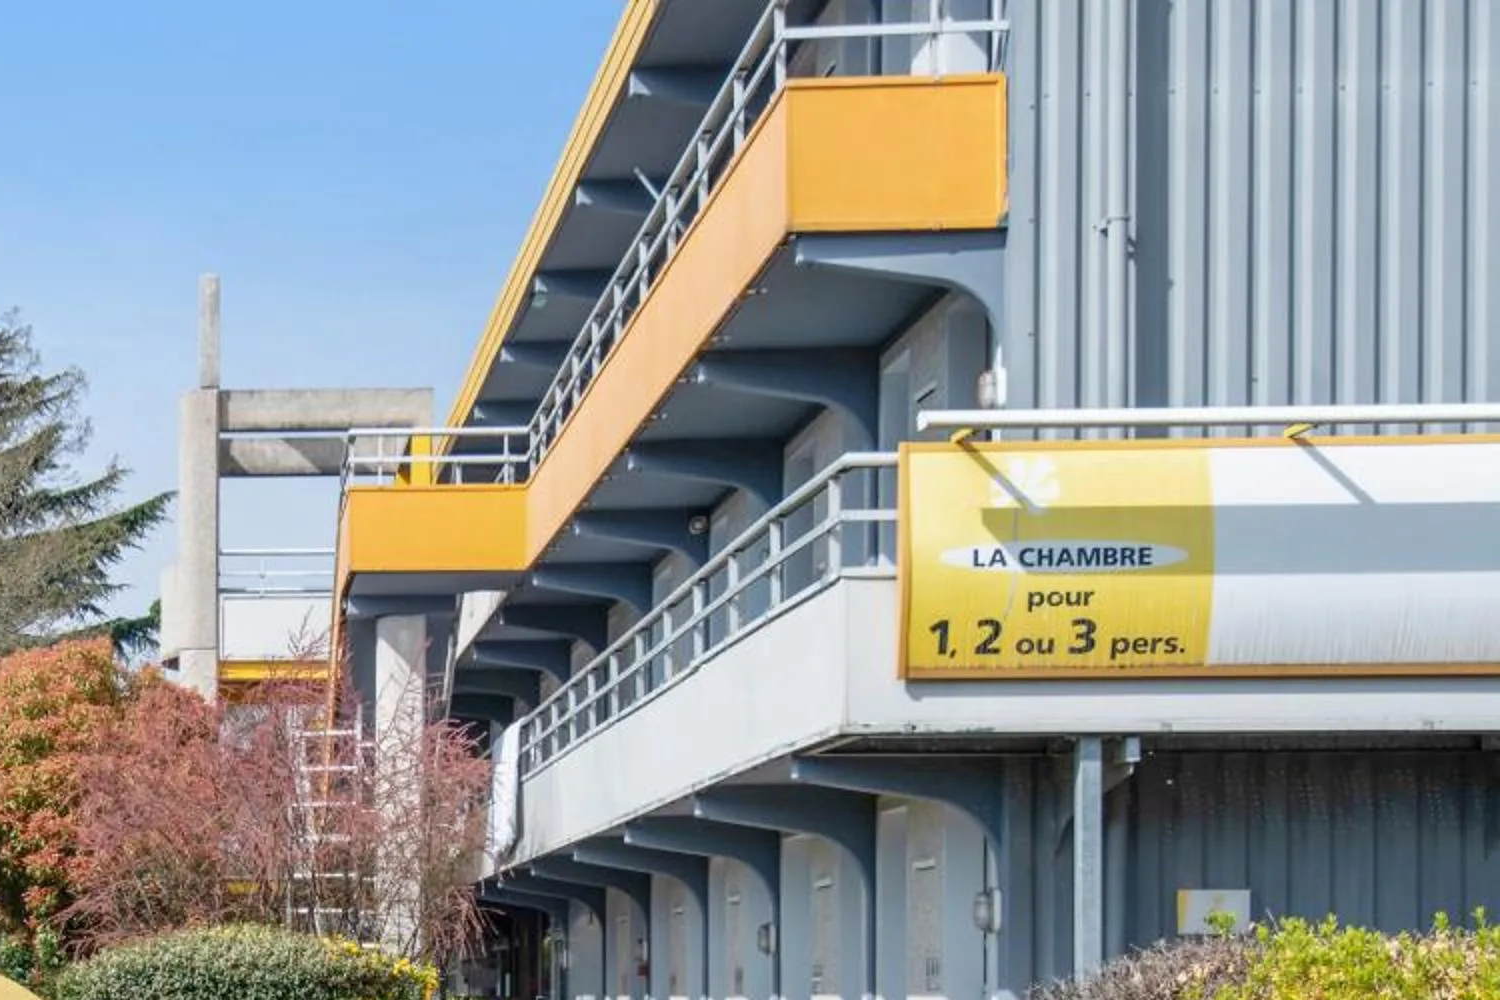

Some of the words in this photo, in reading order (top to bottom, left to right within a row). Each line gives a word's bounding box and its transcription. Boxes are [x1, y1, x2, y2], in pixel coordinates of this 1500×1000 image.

[973, 547, 1007, 568] LA
[1018, 546, 1154, 568] CHAMBRE
[1027, 590, 1095, 613] pour
[929, 618, 957, 659] 1,
[974, 618, 1002, 655] 2
[1015, 637, 1055, 655] ou
[1068, 617, 1097, 655] 3
[1110, 636, 1186, 661] pers.
